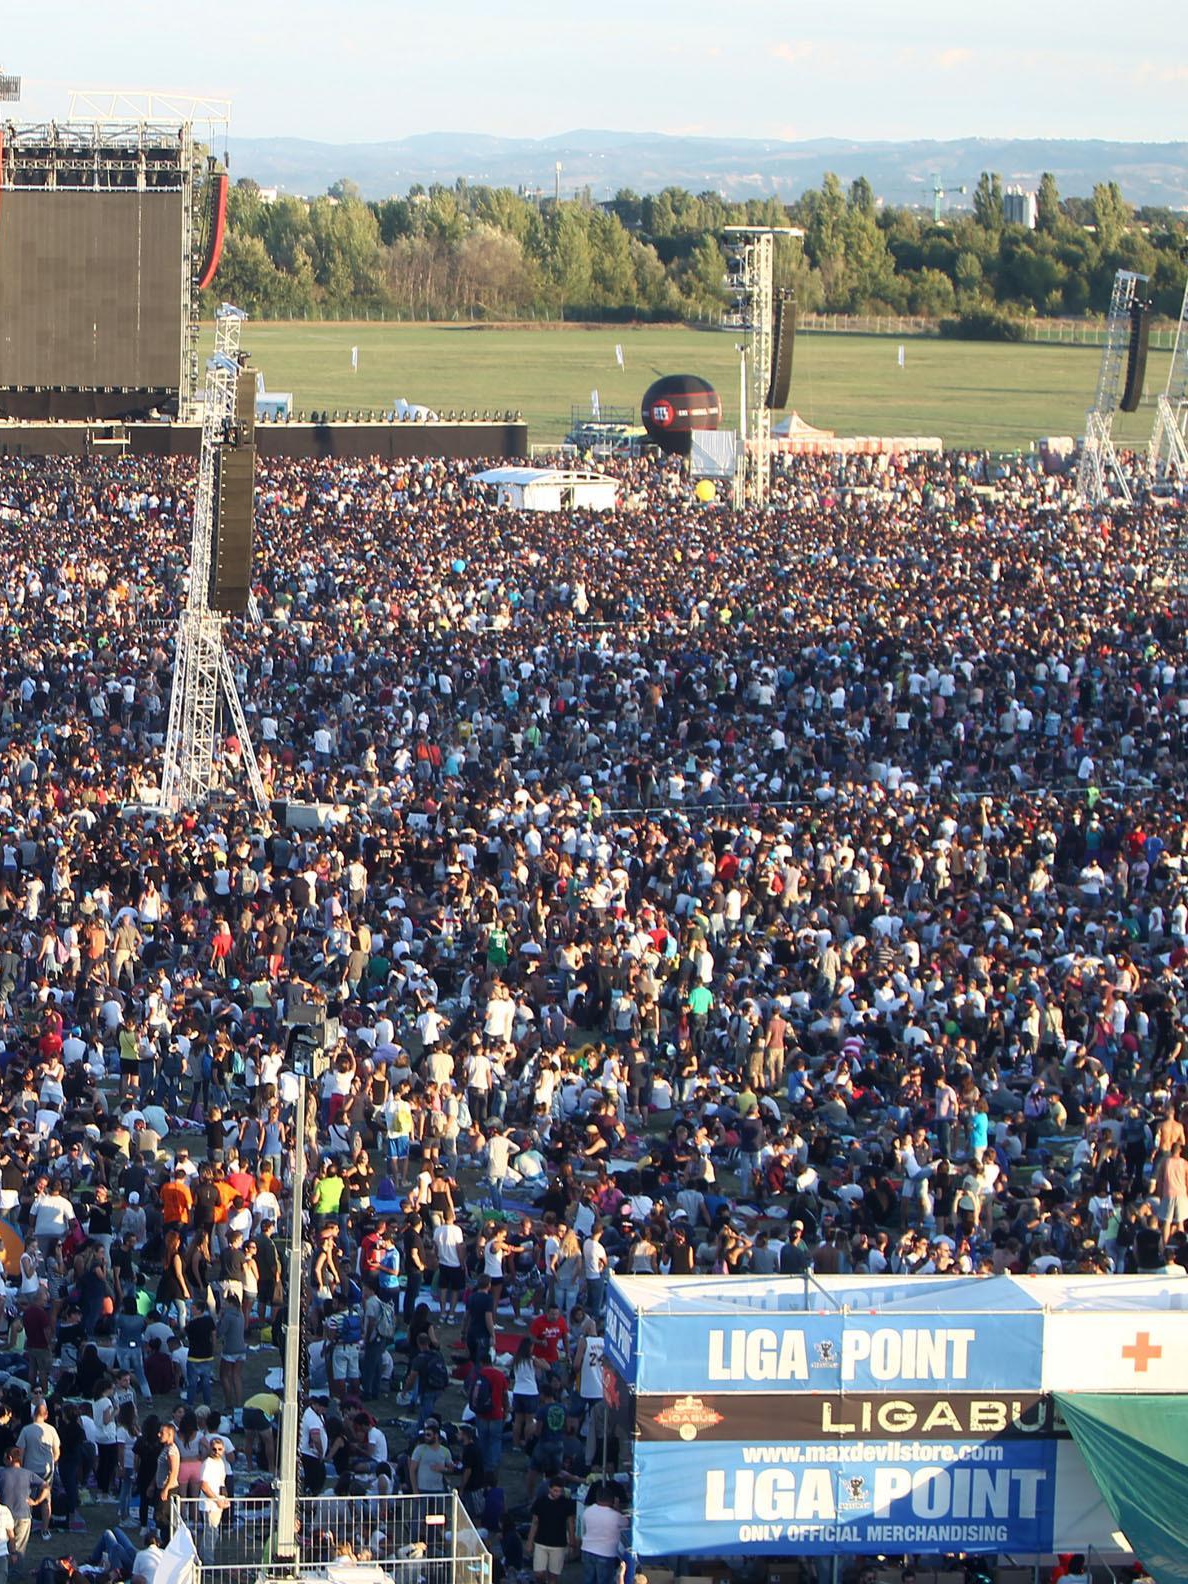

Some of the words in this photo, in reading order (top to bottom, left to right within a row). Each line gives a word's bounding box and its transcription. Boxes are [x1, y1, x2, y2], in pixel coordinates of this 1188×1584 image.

[708, 1329, 810, 1381] LIGA
[841, 1328, 976, 1381] POINT
[742, 1442, 1003, 1462] www.maxdevilstore.com
[705, 1468, 837, 1521] LIGA
[873, 1468, 1047, 1520] POINT
[739, 1525, 783, 1543] ONLY
[788, 1525, 859, 1543] OFFICIAL
[867, 1524, 1008, 1542] MERCHANDISING
